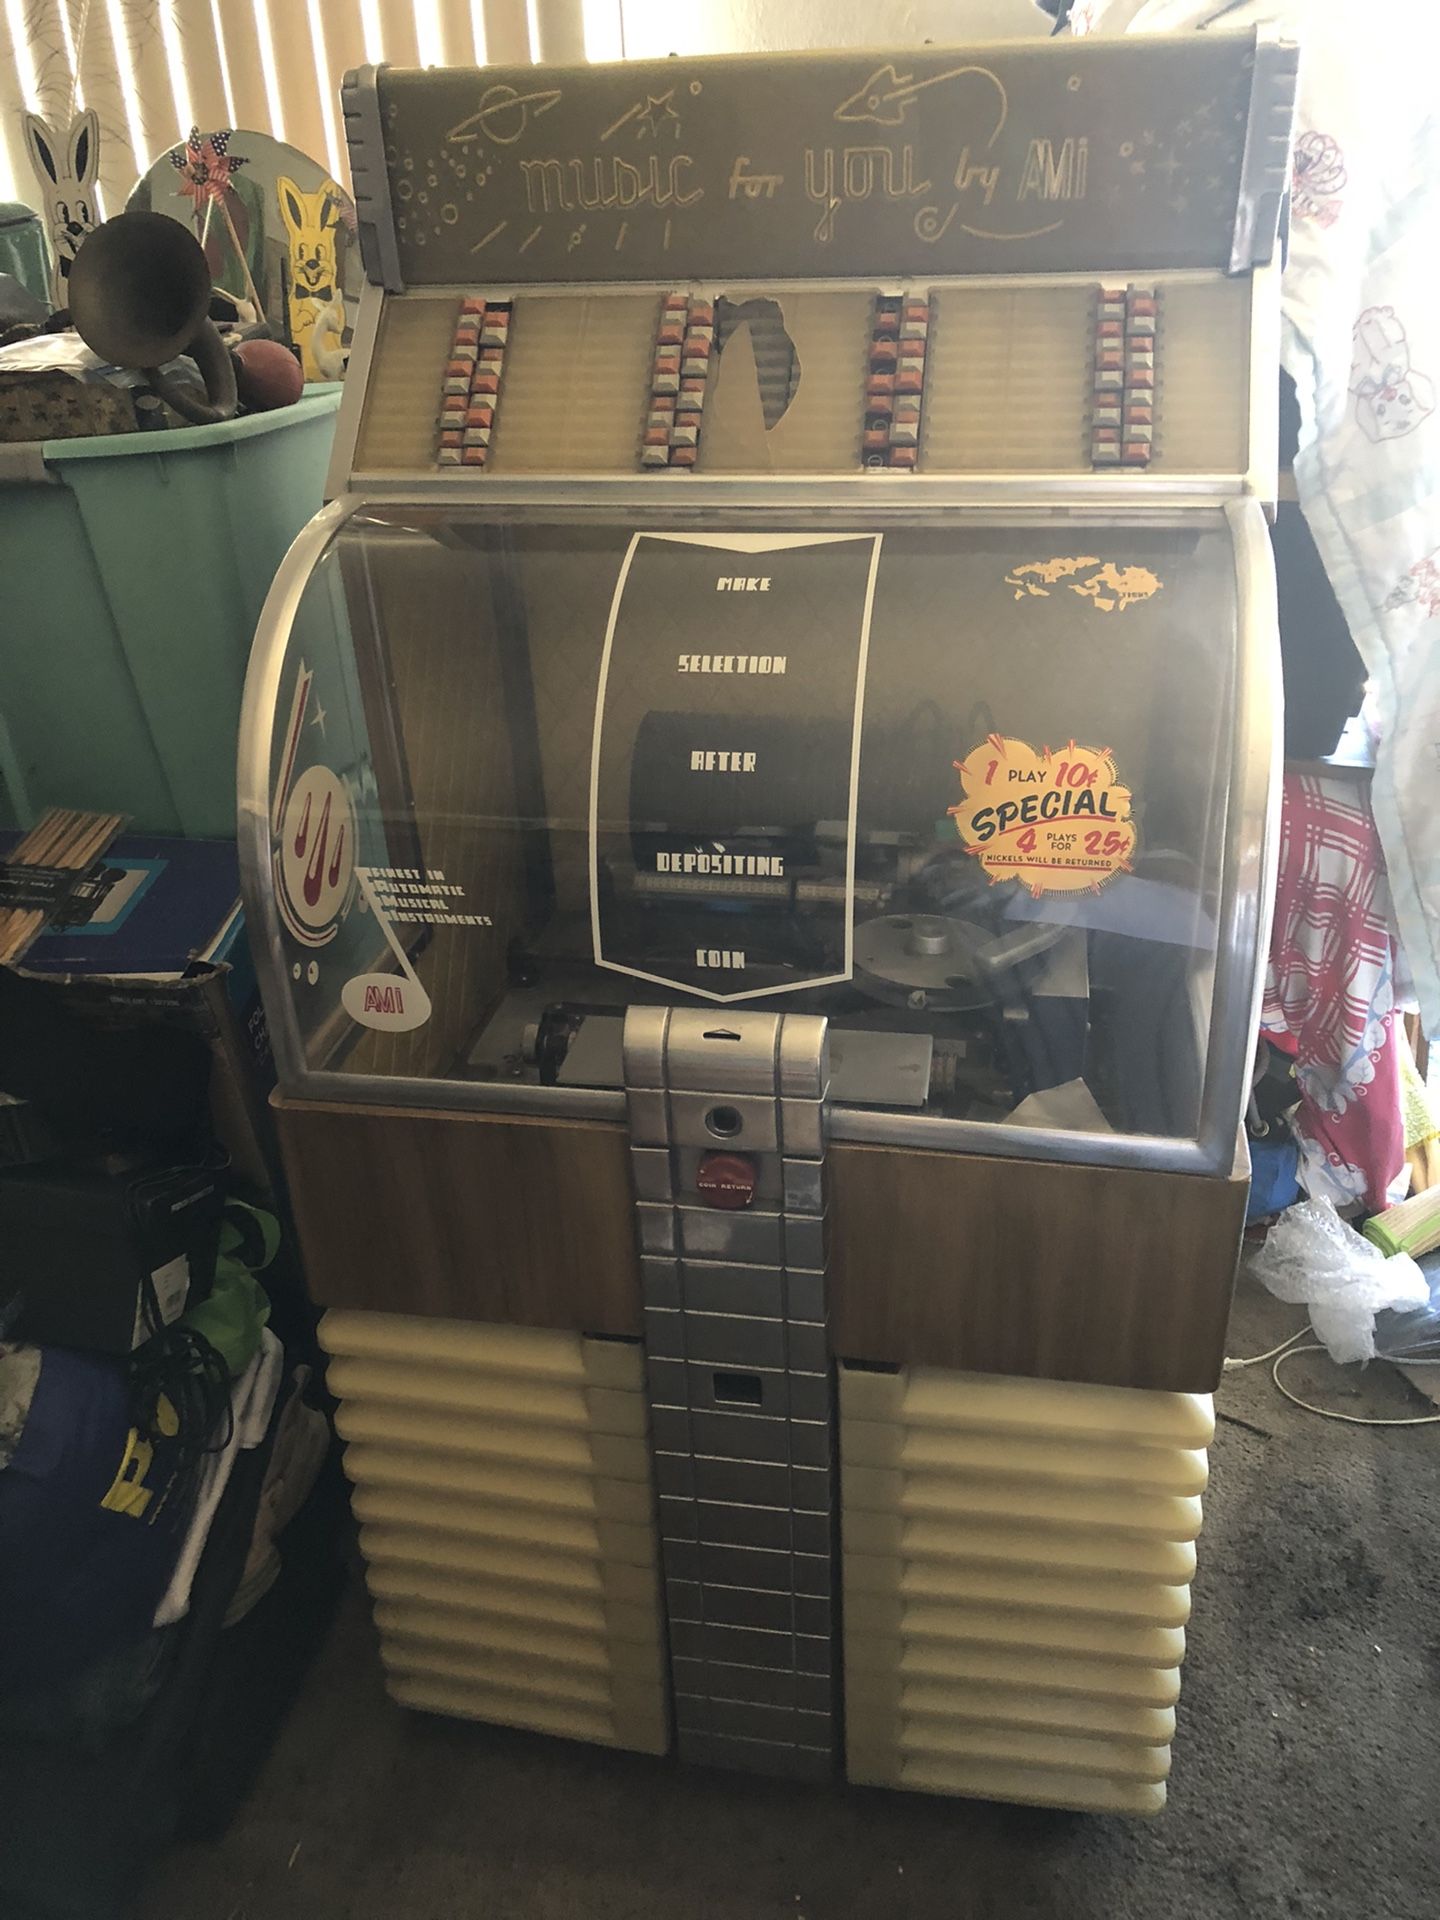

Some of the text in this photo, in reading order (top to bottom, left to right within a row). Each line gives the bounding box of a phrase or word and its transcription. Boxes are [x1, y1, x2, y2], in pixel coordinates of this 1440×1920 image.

[727, 156, 784, 199] for
[804, 144, 932, 243] you
[953, 146, 999, 205] by
[716, 577, 771, 591] MAKE
[678, 655, 787, 674] SELECTION
[690, 751, 756, 772] AFTER
[985, 760, 998, 785] 1
[1008, 769, 1048, 783] PLAY
[971, 789, 1117, 842] SPECIAL
[1016, 828, 1037, 854] 4
[1047, 833, 1077, 842] PLAYS
[1051, 843, 1072, 851] FOR
[656, 852, 784, 877] DEPOSITING
[427, 870, 445, 881] IN
[696, 949, 745, 969] COIN
